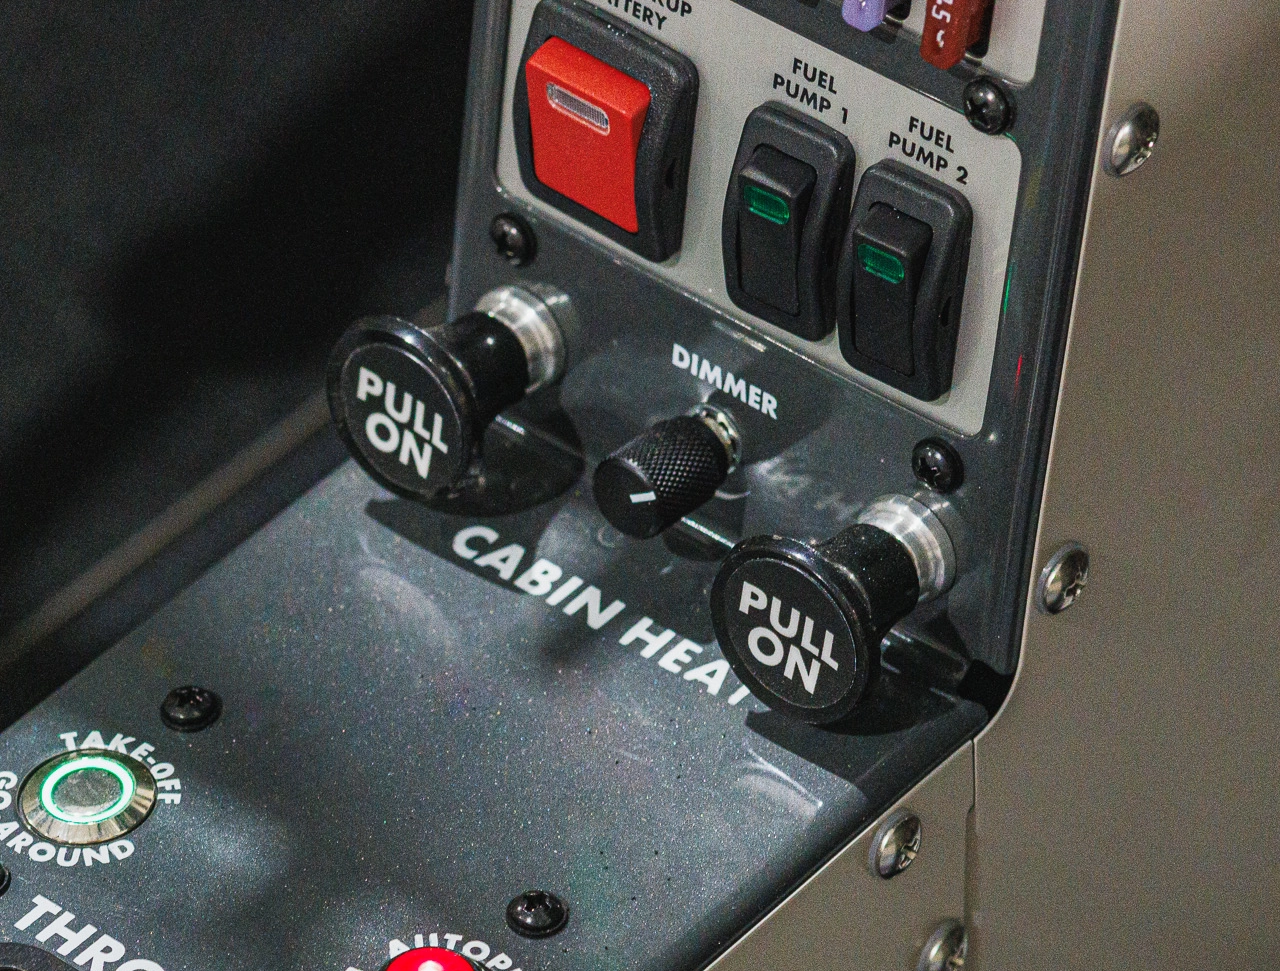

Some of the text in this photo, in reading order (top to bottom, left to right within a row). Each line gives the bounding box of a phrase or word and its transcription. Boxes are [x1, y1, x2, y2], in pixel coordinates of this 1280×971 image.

[773, 73, 848, 124] PUMP 1
[792, 57, 837, 94] FUEL
[888, 131, 968, 185] PUMP 2
[909, 116, 954, 153] FUEL
[357, 366, 448, 455] PULL
[671, 343, 778, 421] DIMMER
[364, 412, 433, 480] ON
[452, 524, 626, 632] CABIN
[738, 580, 838, 672] PULL
[747, 627, 822, 696] ON
[59, 730, 182, 805] TAKE-OFF
